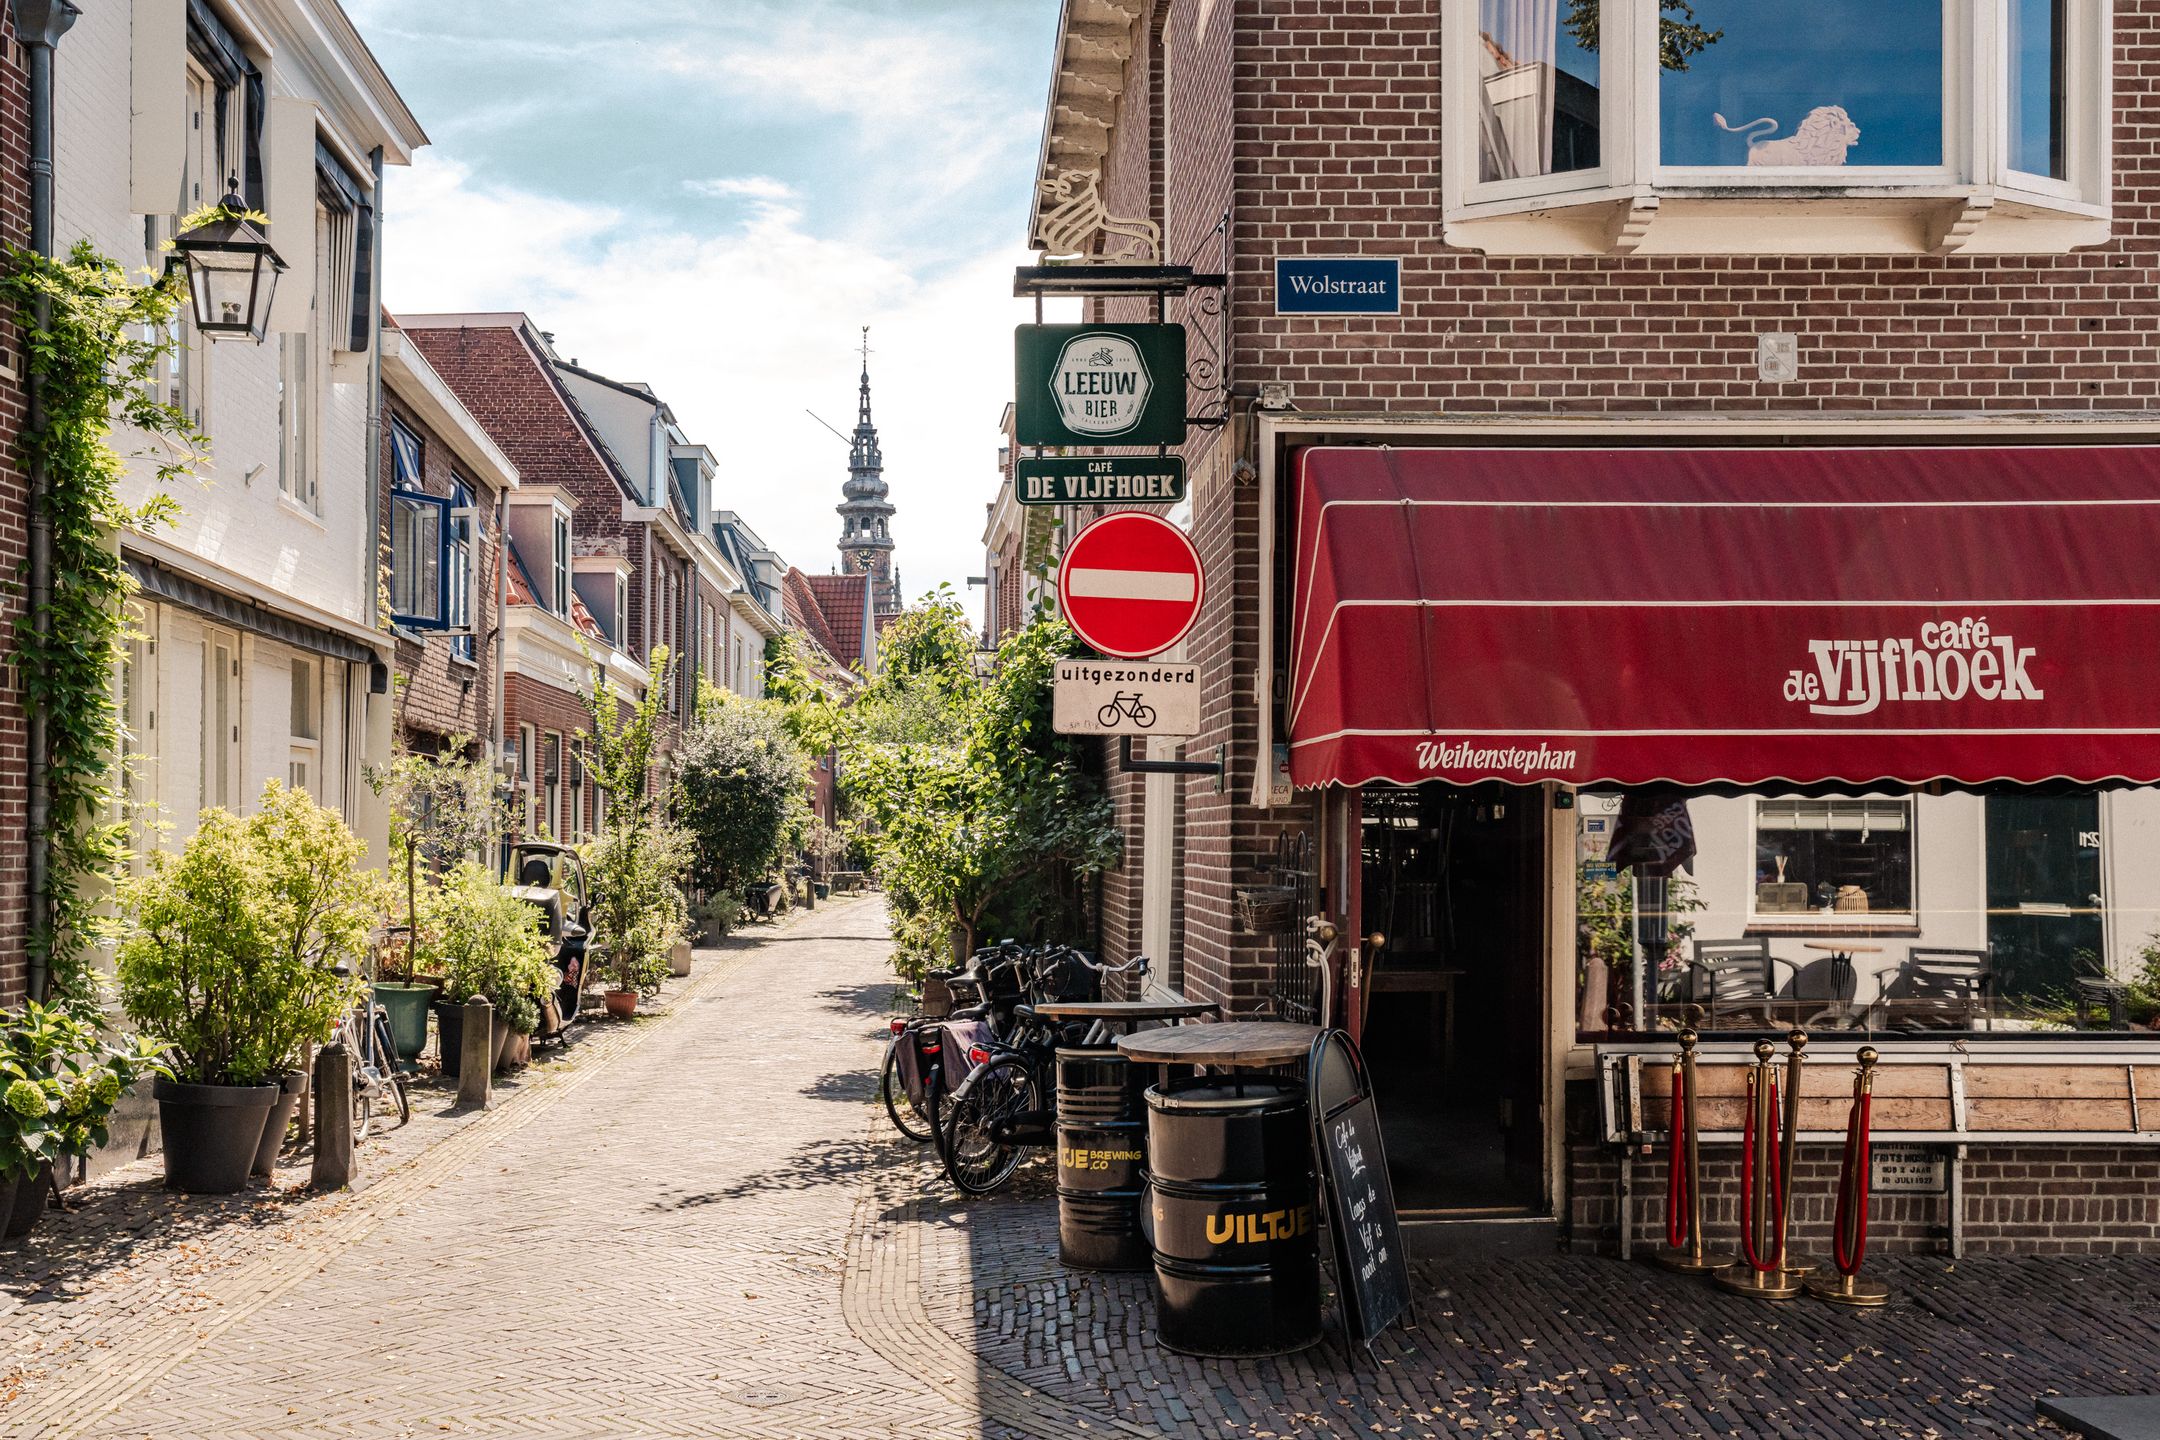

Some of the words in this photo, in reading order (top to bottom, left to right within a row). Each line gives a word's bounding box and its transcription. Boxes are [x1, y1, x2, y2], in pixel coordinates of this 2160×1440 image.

[1289, 274, 1387, 294] Wolstraat
[1064, 371, 1137, 395] LEEUW
[1085, 400, 1117, 417] BIER
[1088, 461, 1113, 473] CAFÉ
[1027, 476, 1055, 499] DE
[1063, 475, 1176, 499] VIJFHOEK
[1921, 616, 1989, 650] café
[1062, 666, 1194, 685] uitgezonderd
[1783, 670, 1819, 702] de
[1808, 635, 2044, 716] Vijfhoek
[1415, 741, 1577, 775] Weihenstephan
[1090, 1150, 1142, 1160] BREWING
[1910, 1166, 1932, 1174] JAAR
[1894, 1176, 1914, 1184] JULI
[1205, 1204, 1312, 1245] UILTJE
[1374, 1223, 1383, 1239] is
